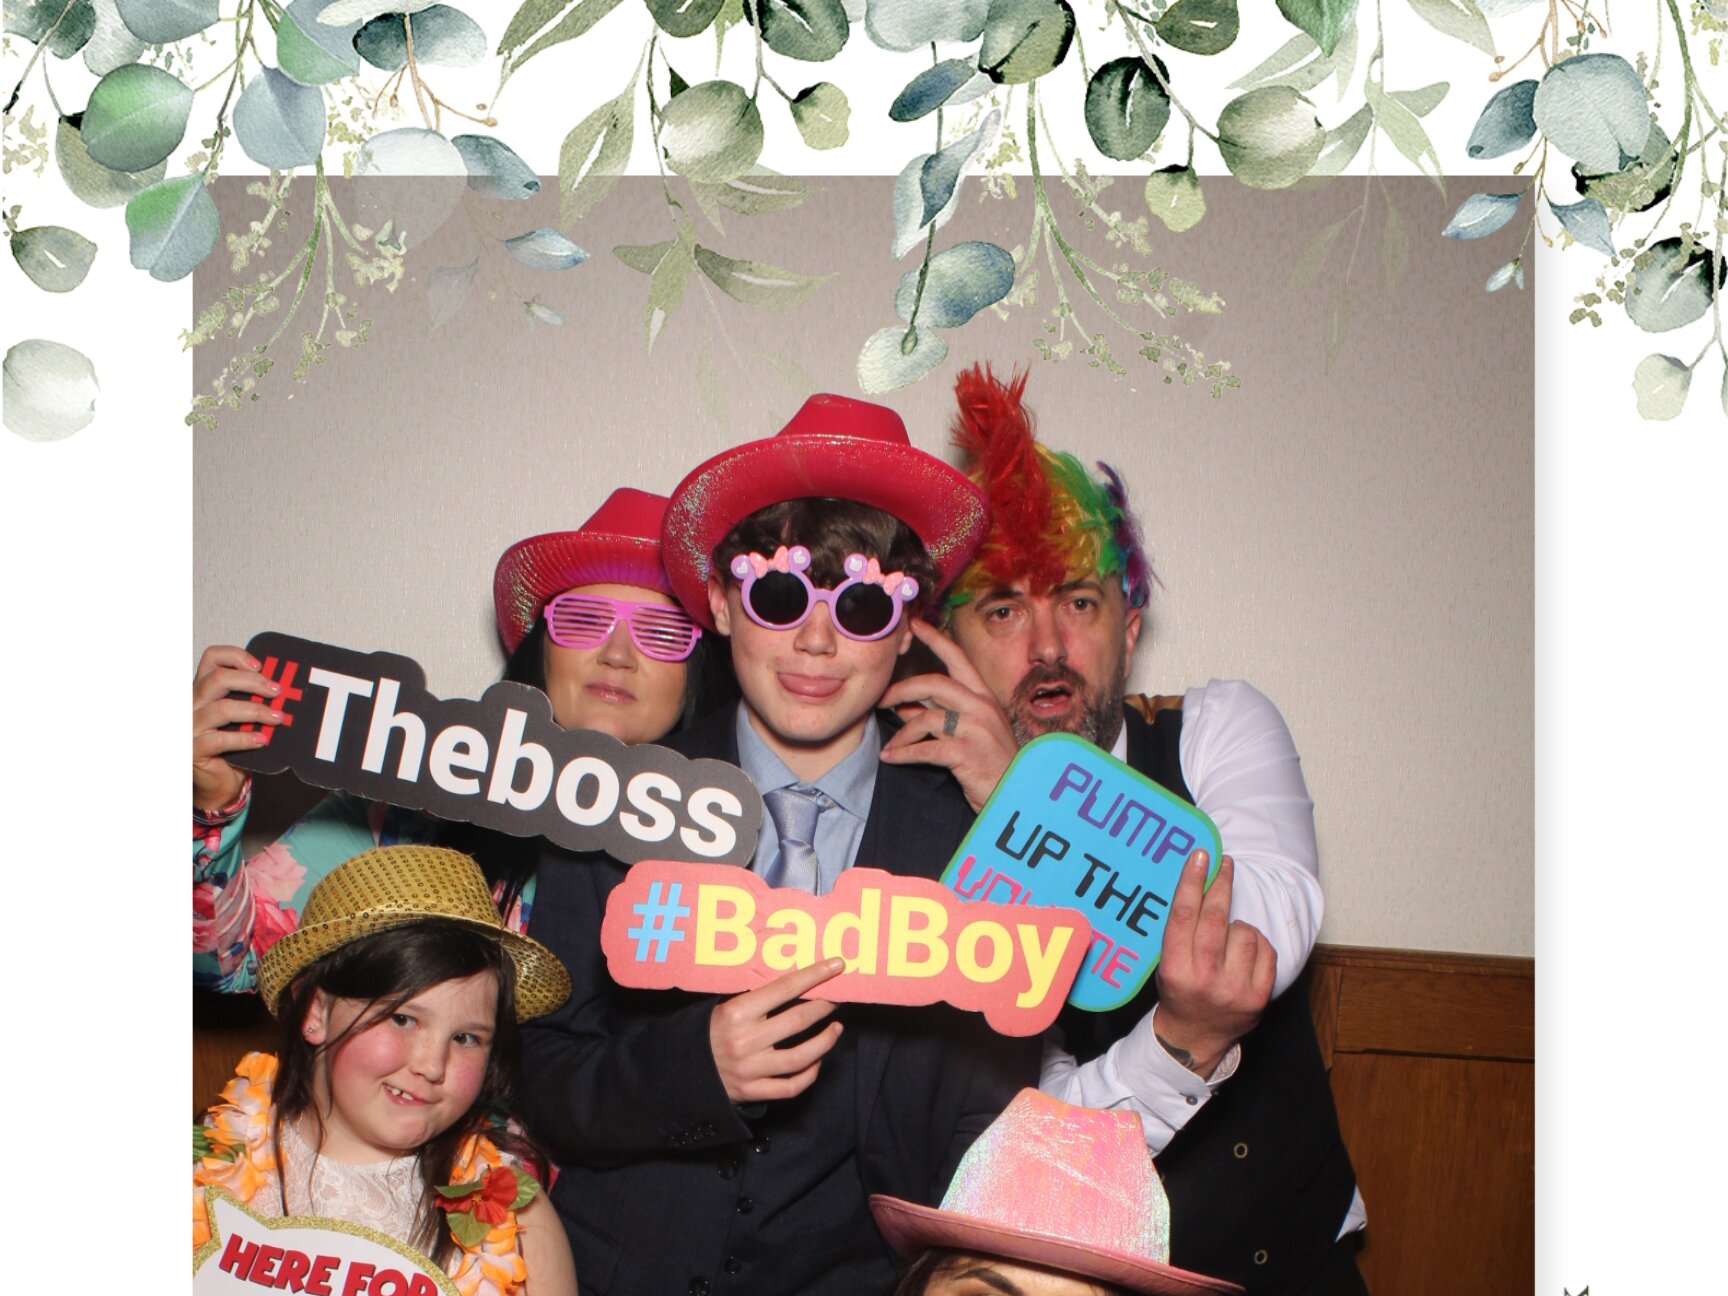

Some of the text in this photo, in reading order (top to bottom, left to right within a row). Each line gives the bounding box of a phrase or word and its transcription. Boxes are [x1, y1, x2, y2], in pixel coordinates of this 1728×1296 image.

[239, 655, 743, 858] #Theboss
[1049, 762, 1197, 865] PUMP
[995, 810, 1168, 937] UP THE
[628, 881, 1075, 1009] #BadBoy
[218, 1233, 340, 1296] HERE
